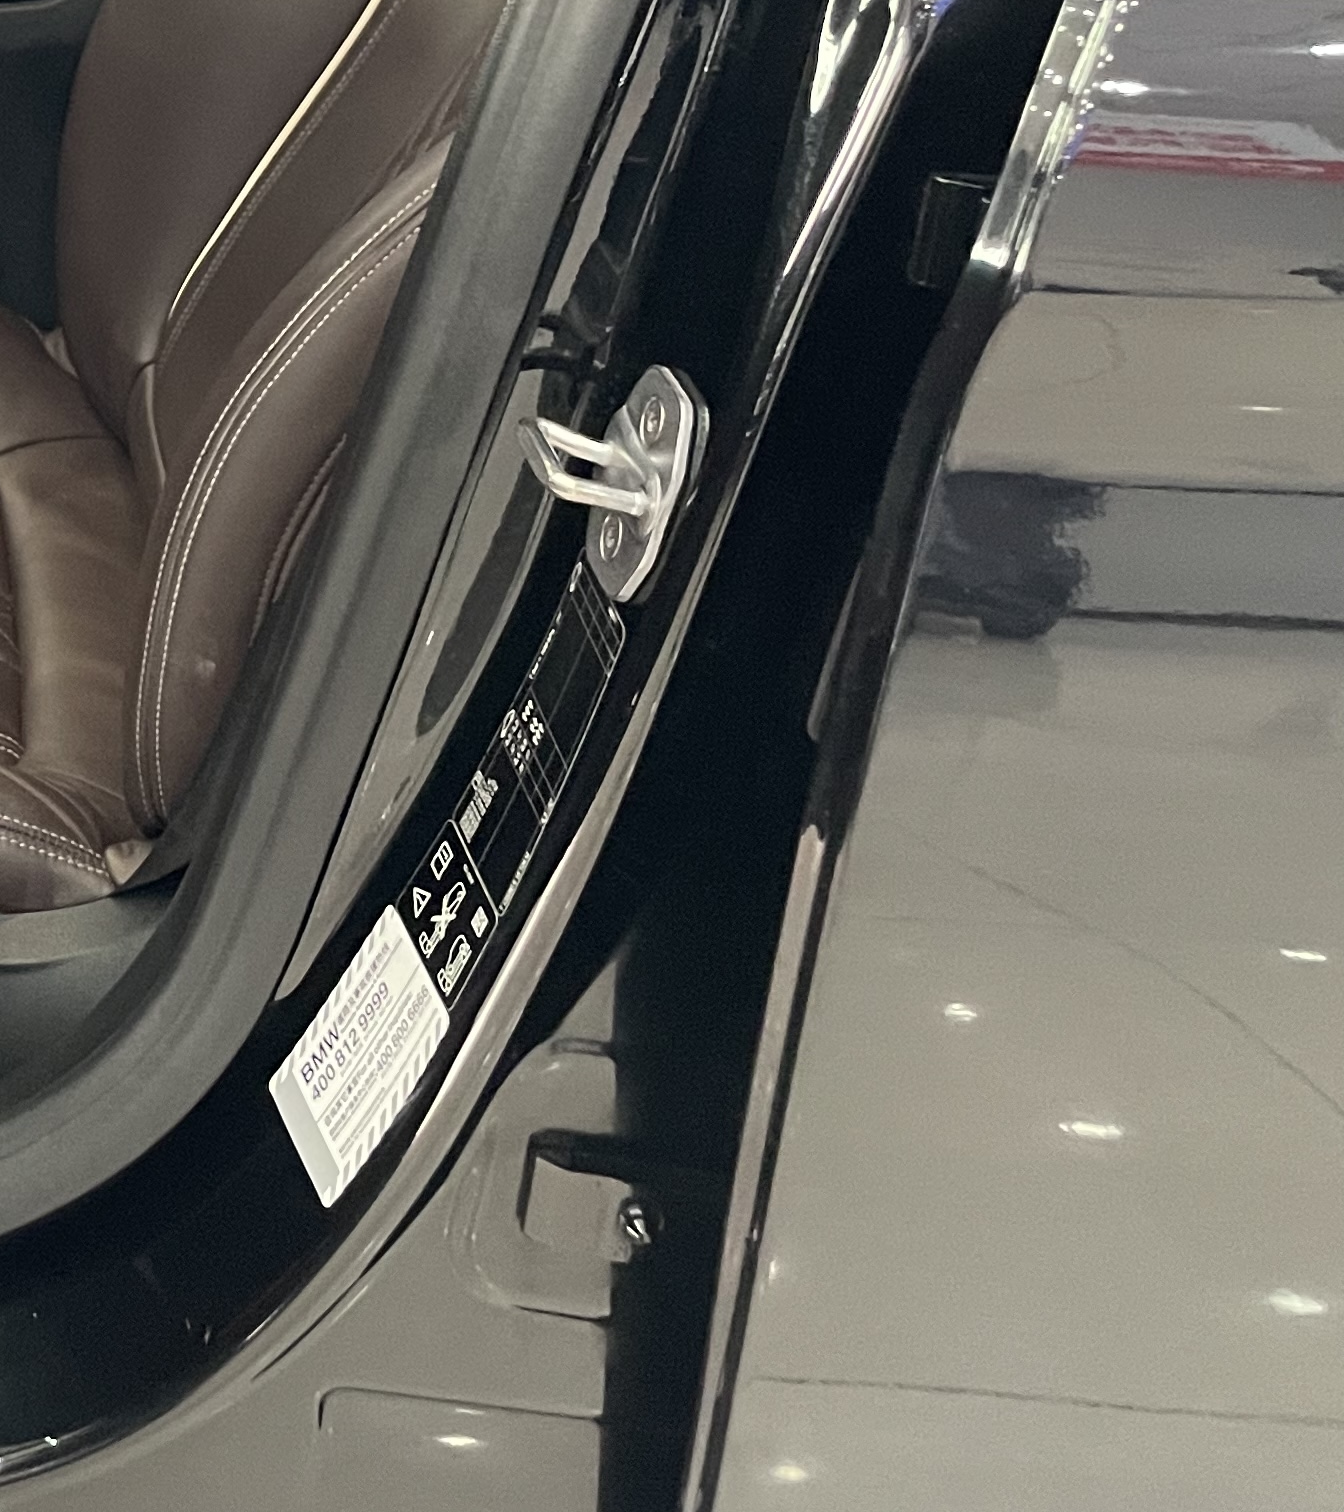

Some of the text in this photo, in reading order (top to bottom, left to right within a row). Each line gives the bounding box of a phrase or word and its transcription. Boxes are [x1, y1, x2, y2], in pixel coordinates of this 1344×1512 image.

[300, 1021, 340, 1085] BMW
[312, 1063, 336, 1101] 400
[334, 1028, 358, 1068] 812
[358, 981, 390, 1032] 9999
